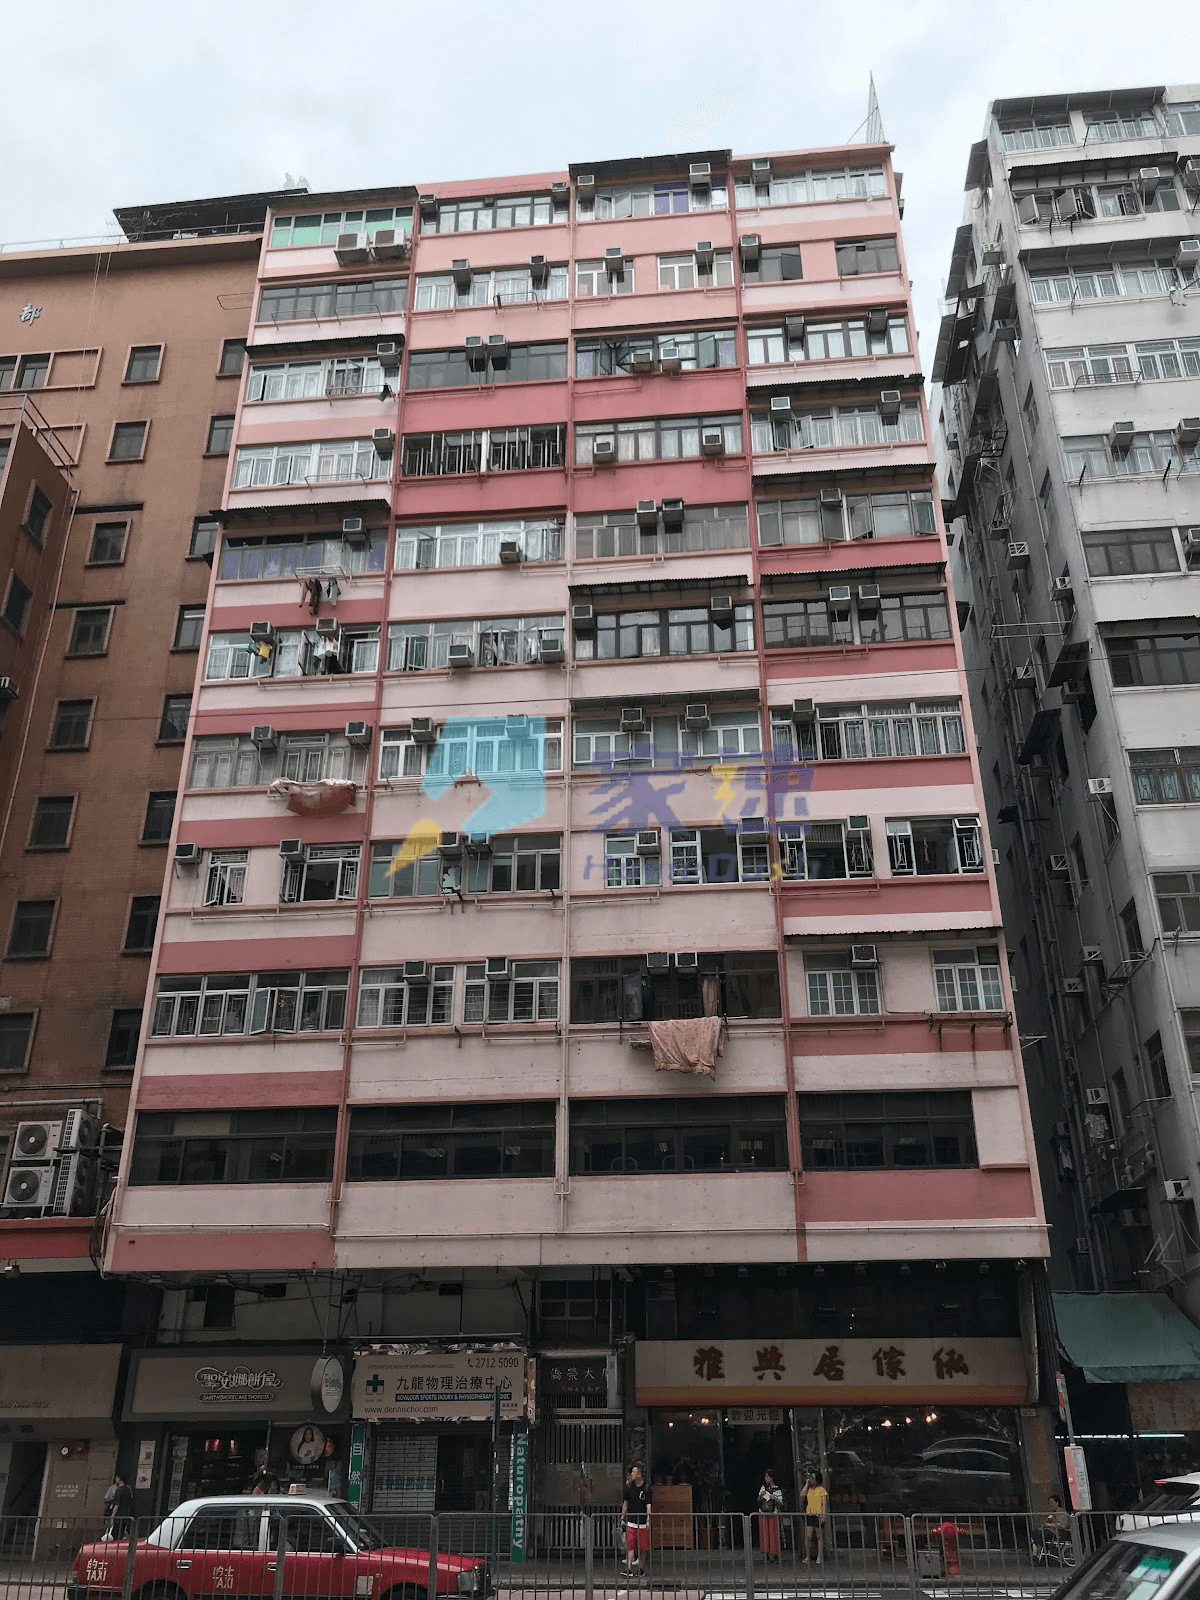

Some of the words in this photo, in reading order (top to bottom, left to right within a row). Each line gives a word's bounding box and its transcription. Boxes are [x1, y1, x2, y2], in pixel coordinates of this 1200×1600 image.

[20, 303, 43, 326] 部
[476, 1358, 496, 1368] 2712
[499, 1358, 519, 1368] 5090
[693, 1346, 969, 1381] 雅典居傢俬
[396, 1376, 513, 1391] 九龍物理治療中心
[364, 1405, 439, 1414] www.dennischoi.com
[731, 1409, 780, 1421] 歡迎光臨
[87, 1559, 108, 1570] 的士
[86, 1569, 107, 1581] TAXI
[212, 1565, 234, 1577] 的士
[212, 1577, 234, 1589] TAXI
